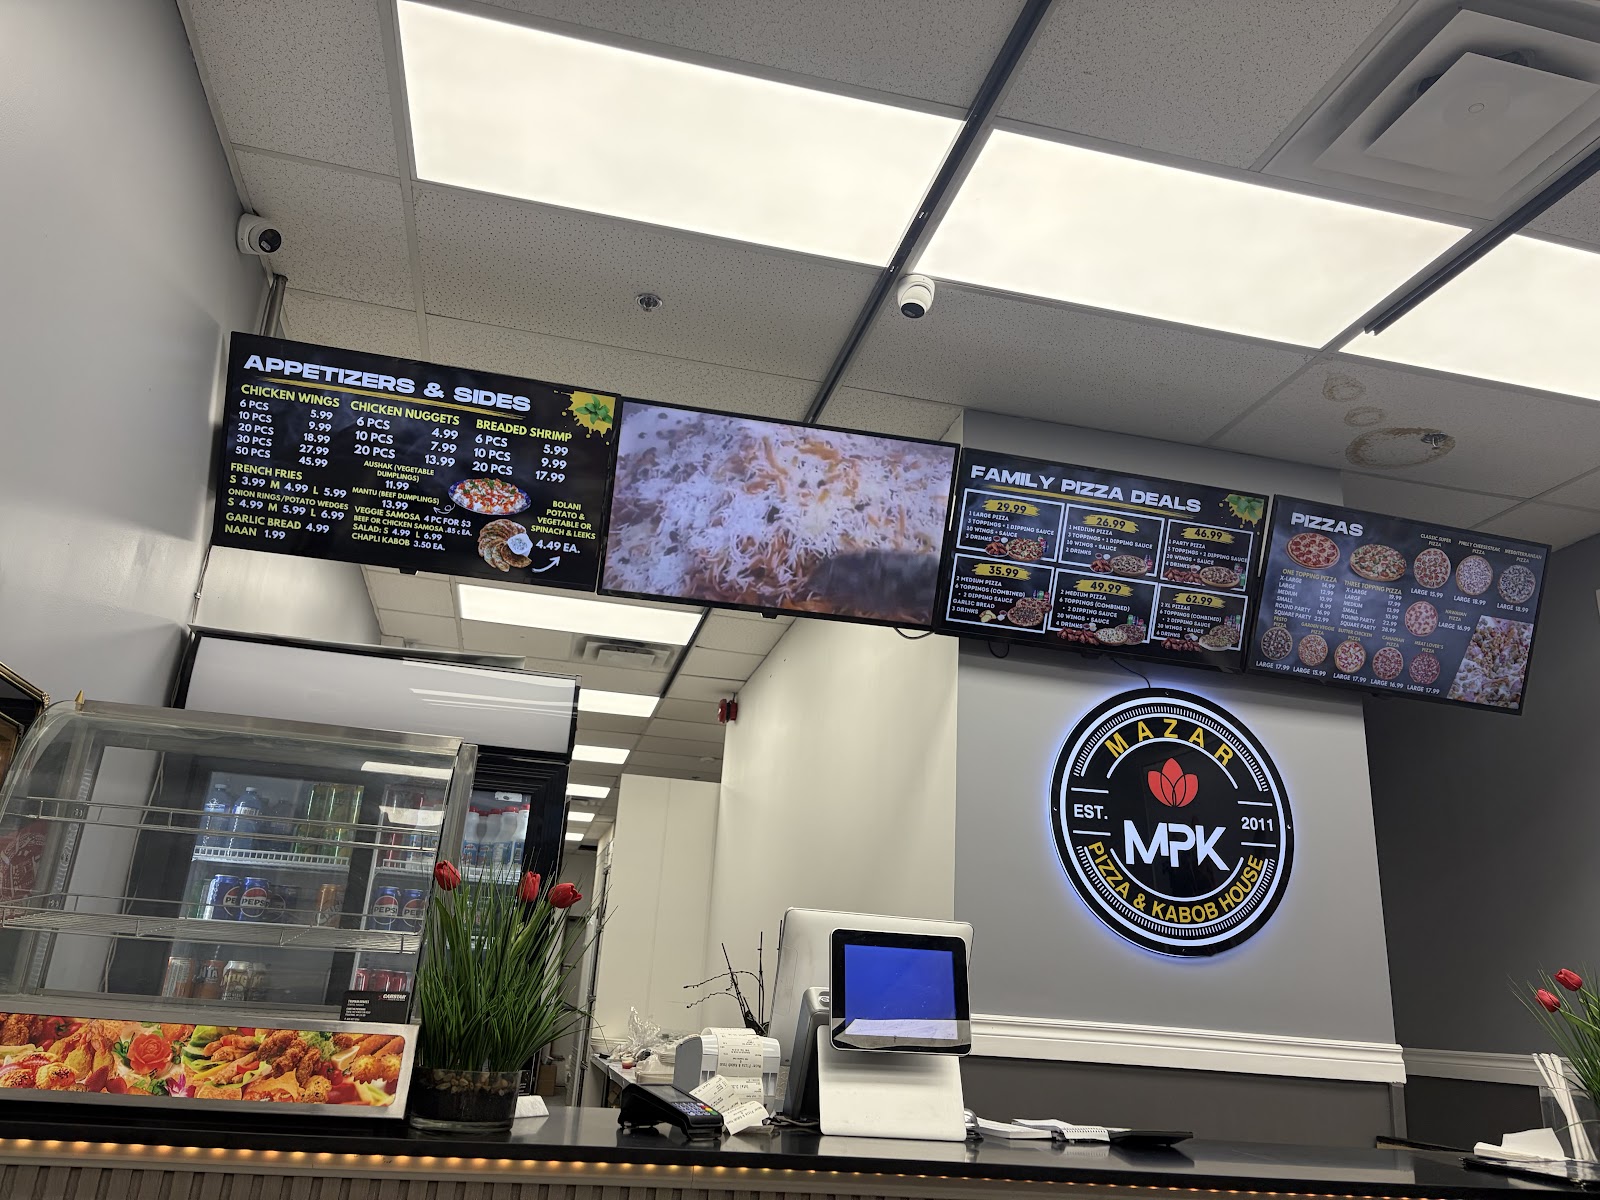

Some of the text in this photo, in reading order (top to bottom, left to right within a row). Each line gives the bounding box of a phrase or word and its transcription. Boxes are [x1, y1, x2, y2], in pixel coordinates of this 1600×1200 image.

[243, 354, 531, 412] APPETIZERS & SIDES
[241, 384, 340, 407] CHICKEN WINGS
[249, 401, 269, 410] PCS
[252, 413, 272, 423] PCS
[310, 410, 333, 420] 5.99
[350, 400, 460, 425] CHICKEN NUGGETS
[238, 423, 274, 435] 20 PCS
[308, 422, 331, 432] 9.99
[476, 419, 572, 441] BREADED SHRIMP
[304, 433, 330, 444] 18.99
[432, 428, 458, 440] 4.99
[236, 435, 272, 446] 30 PCS
[236, 446, 270, 458] 50 PCS
[299, 445, 329, 456] 27.99
[430, 441, 457, 454] 7.99
[543, 445, 568, 456] 5.99
[299, 456, 328, 467] 45.99
[425, 455, 455, 467] 13.99
[541, 458, 567, 469] 9.99
[231, 463, 302, 480] FRENCH FRIES
[364, 460, 434, 476] AUSHAK (VEGETABLE
[377, 470, 419, 482] DUMPLINGS)
[535, 471, 565, 482] 17.99
[230, 475, 346, 498] S 3.99 M 4.99 L 5.99
[385, 480, 409, 490] 11.99
[971, 465, 1202, 512] FAMILY PIZZA DEALS
[228, 488, 349, 510] ONION RINGS/POTATO WEDGES
[352, 487, 439, 505] MANTU (BEEF DUMPLINGS)
[228, 498, 234, 506] S
[239, 499, 263, 510] 4.99
[268, 503, 278, 512] M
[283, 505, 306, 515] 5.99
[321, 510, 344, 520] 6.99
[382, 500, 408, 510] 13.99
[553, 501, 581, 510] BOLANI
[997, 502, 1026, 513] 29.99
[354, 506, 384, 516] VEGGIE
[386, 510, 420, 521] SAMOSA
[443, 518, 459, 526] FOR
[461, 520, 471, 528] $3
[546, 509, 577, 519] POTATO
[226, 513, 329, 533] GARLIC BREAD 4.99
[382, 518, 412, 528] CHICKEN
[414, 523, 443, 532] SAMOSA
[537, 517, 579, 529] VEGETABLE
[1097, 518, 1126, 529] 26.99
[1291, 512, 1364, 537] PIZZAS
[225, 525, 285, 539] NAAN 1.99
[352, 523, 381, 533] SALAD:
[424, 532, 442, 541] 6.99
[531, 525, 564, 536] SPINACH
[573, 530, 595, 539] LEEKS
[1195, 529, 1222, 540] 46.99
[352, 532, 445, 551] CHAPLI KABOB 3.50 EA.
[536, 540, 580, 553] 4.49 EA.
[989, 566, 1018, 577] 35.99
[1296, 571, 1319, 579] TOPPING
[1090, 581, 1121, 594] 49.99
[1185, 594, 1212, 605] 62.99
[1104, 717, 1234, 767] MAZAR
[1073, 803, 1274, 831] EST. 2011
[1123, 819, 1230, 872] MPK
[1088, 841, 1264, 923] PIZZA & KABOB HOUSE
